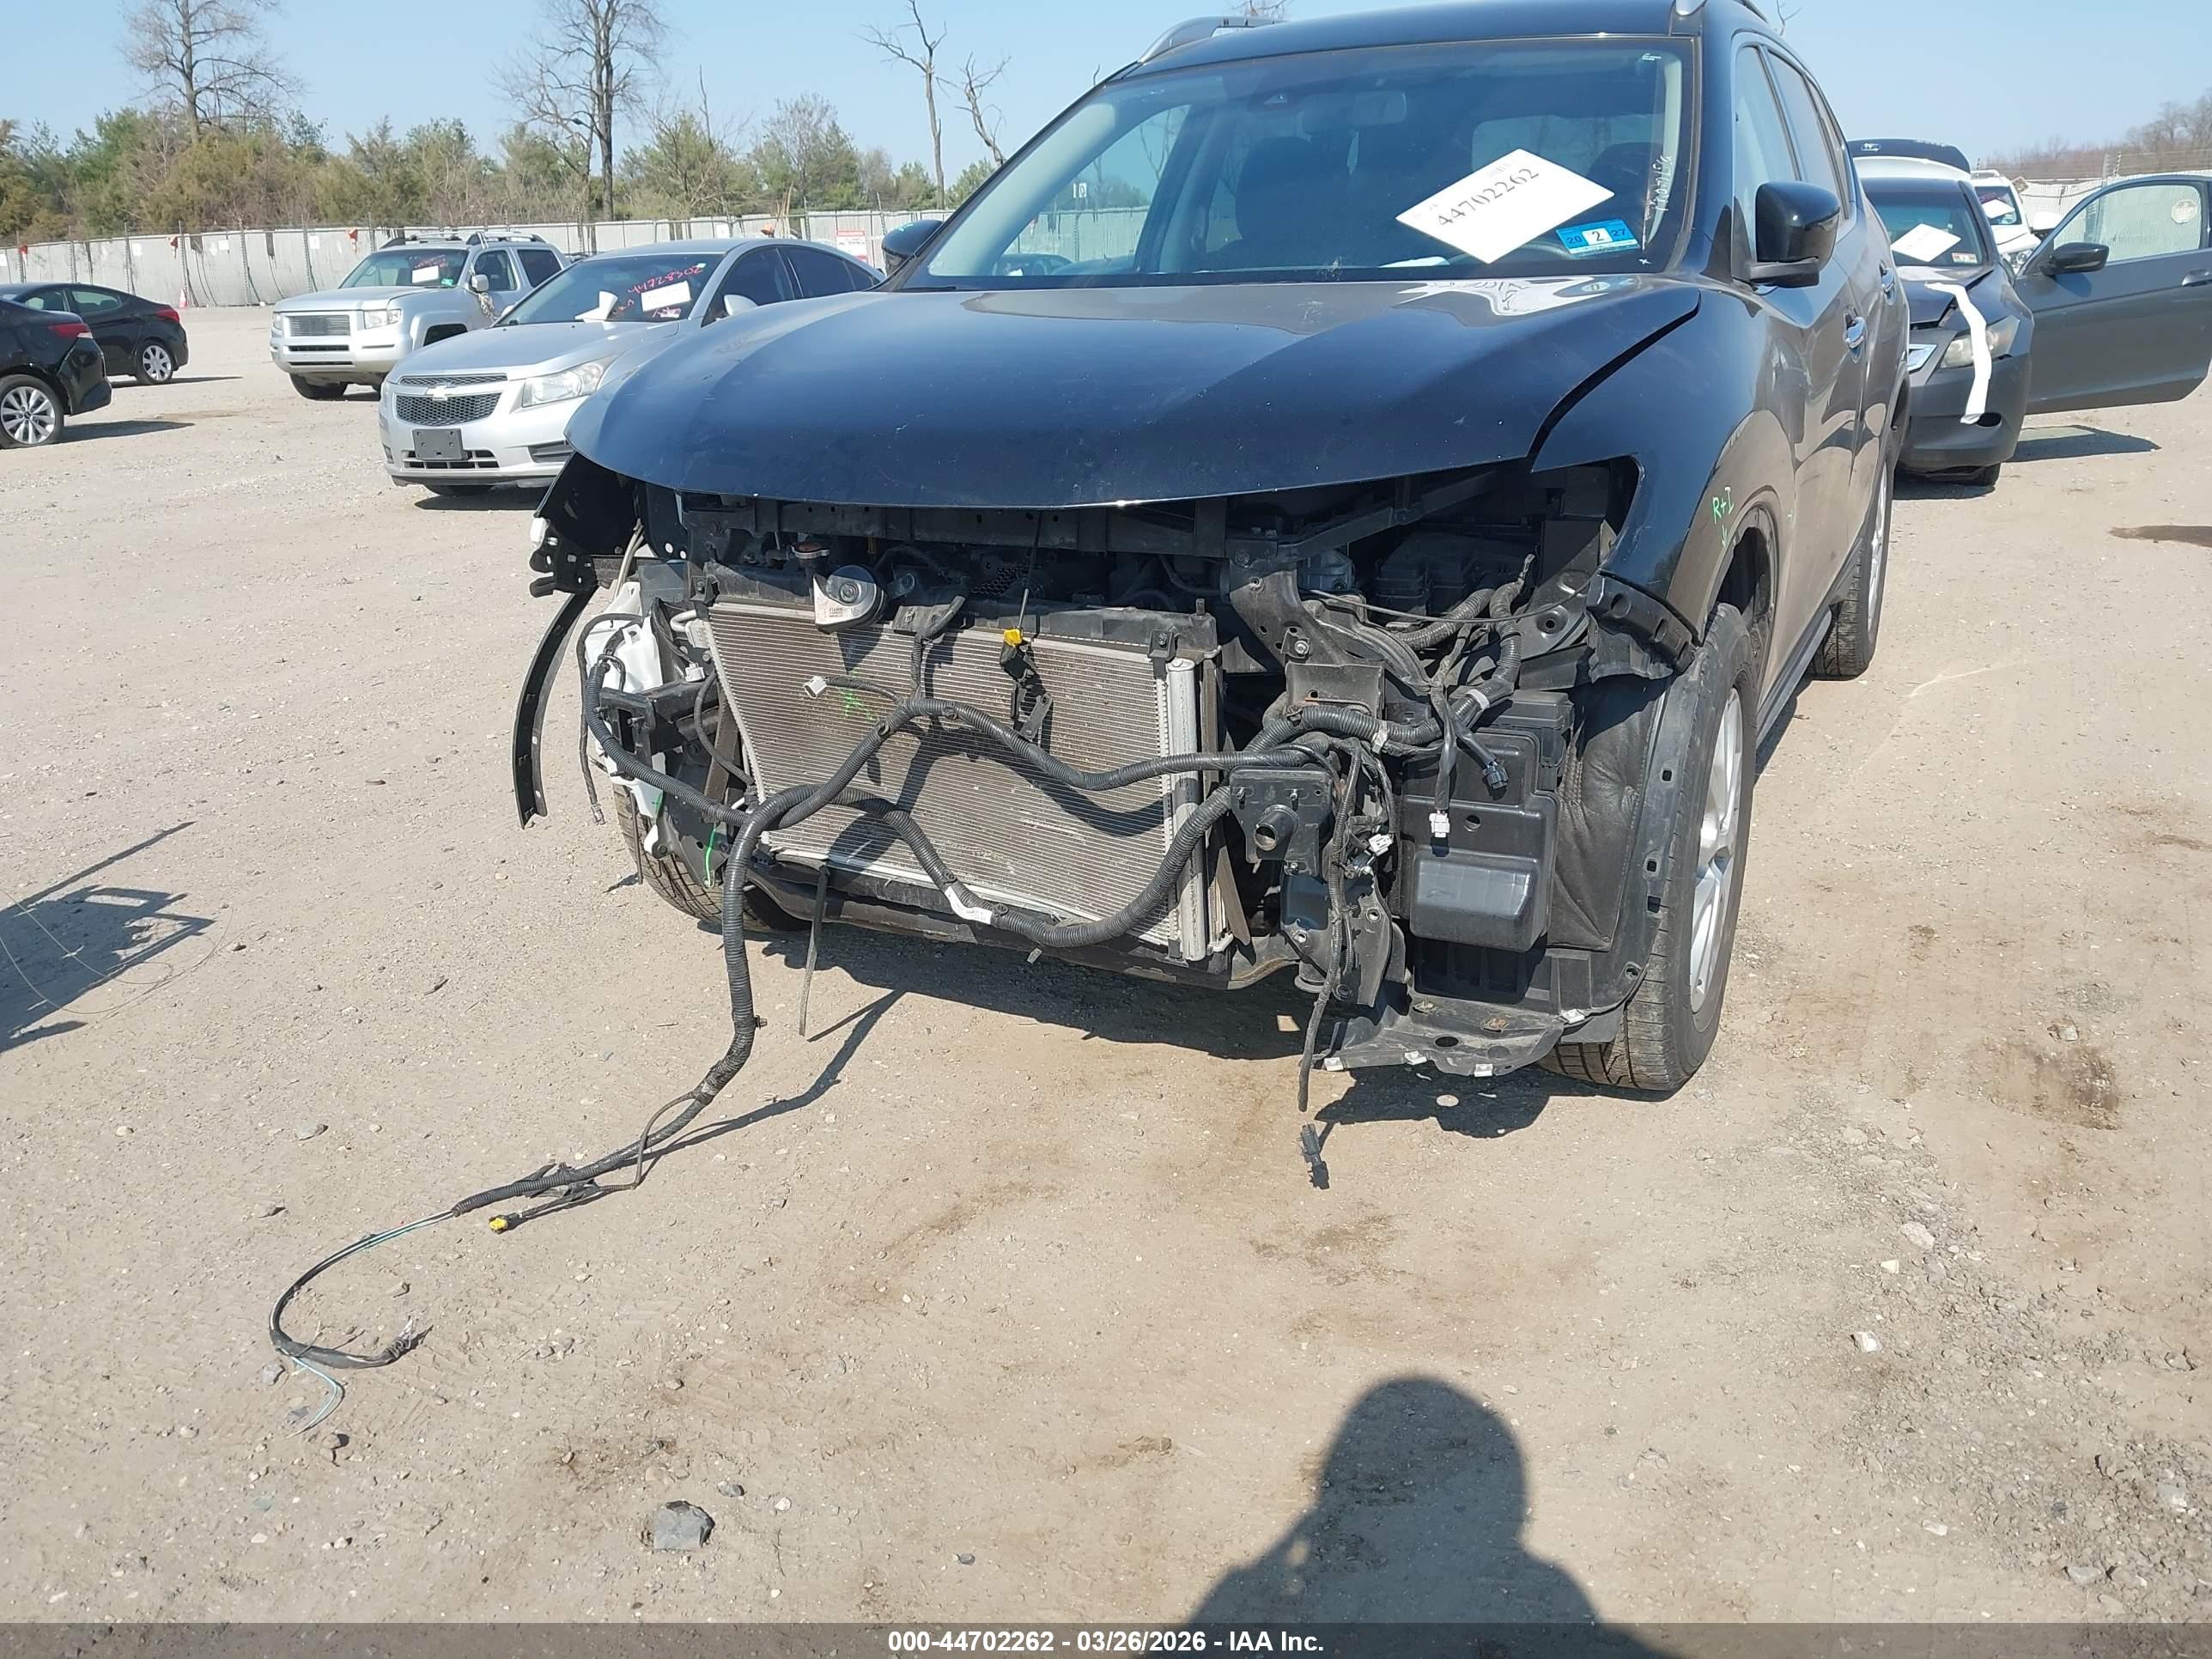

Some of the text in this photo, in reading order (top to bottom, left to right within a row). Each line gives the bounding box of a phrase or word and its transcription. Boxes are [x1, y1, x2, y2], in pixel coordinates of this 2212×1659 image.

[1438, 168, 1540, 226] 44702262
[1566, 228, 1626, 244] 20 2 27
